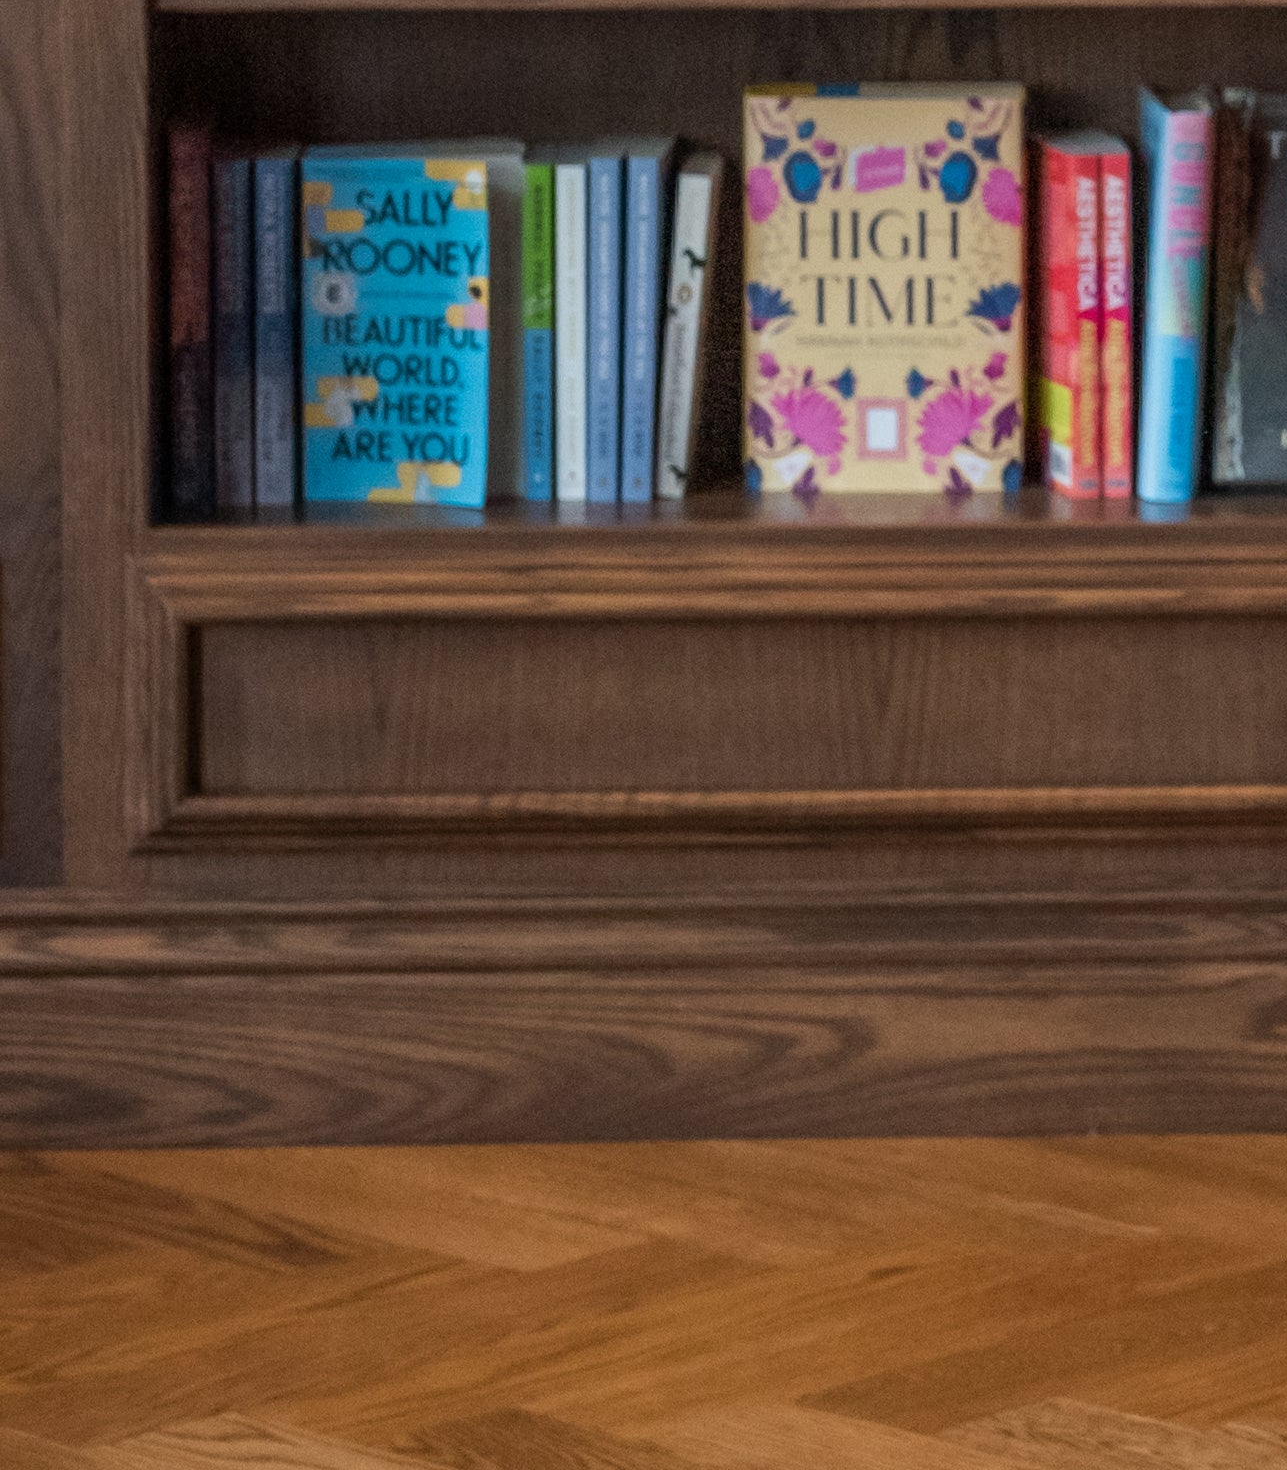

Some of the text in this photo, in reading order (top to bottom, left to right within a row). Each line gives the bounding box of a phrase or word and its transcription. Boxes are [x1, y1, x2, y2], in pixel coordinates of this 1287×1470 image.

[356, 189, 452, 227] SALLY
[800, 209, 959, 260] HIGH
[323, 238, 482, 277] ROONEY
[800, 274, 957, 327] TIME
[322, 316, 482, 350] BEAUTIFUL
[352, 393, 459, 427] WHERE
[332, 430, 471, 467] ARE YOU
